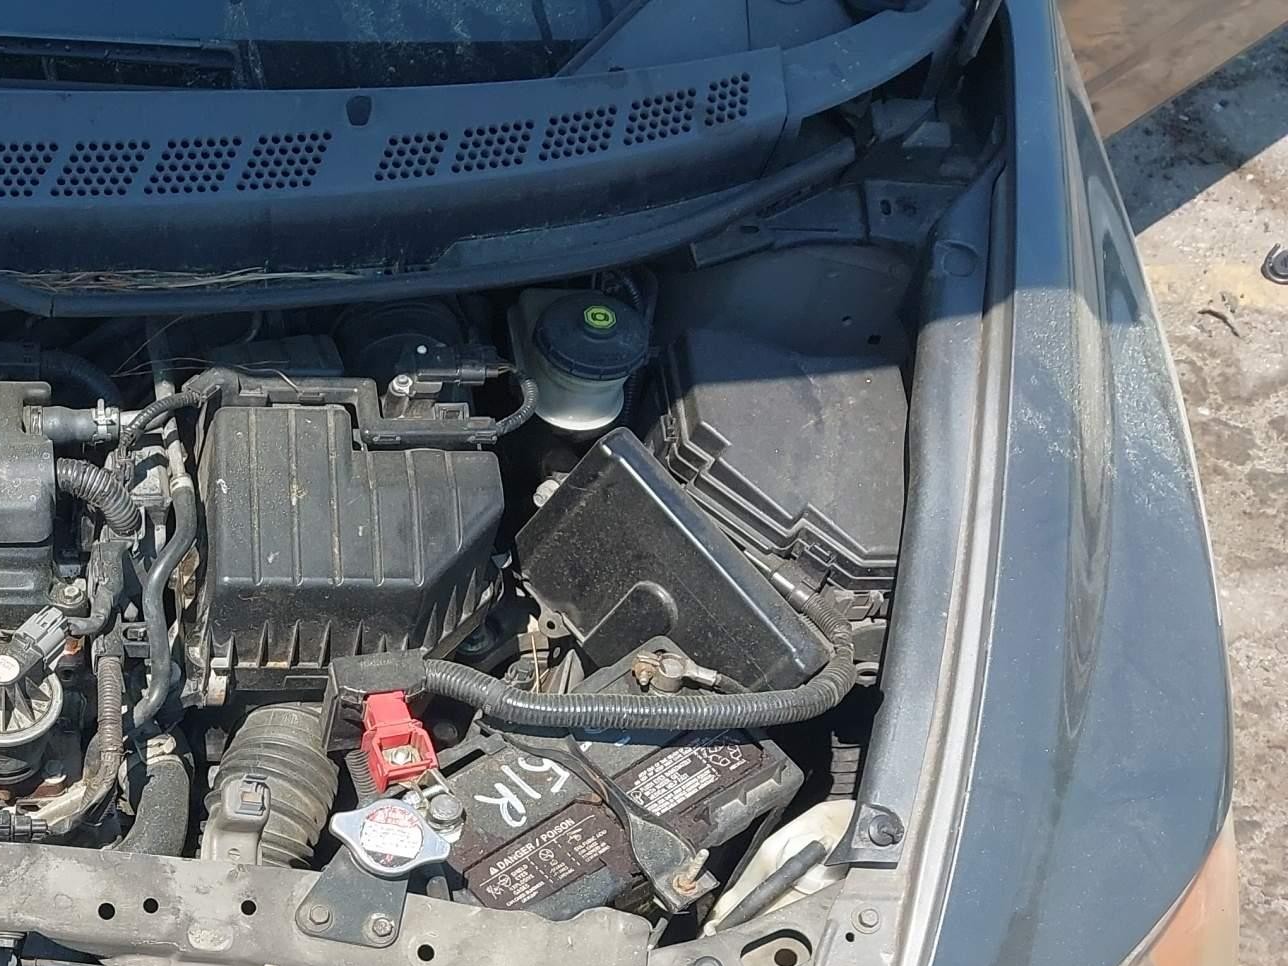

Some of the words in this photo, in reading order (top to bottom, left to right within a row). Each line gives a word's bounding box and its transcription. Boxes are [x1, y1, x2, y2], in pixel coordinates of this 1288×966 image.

[474, 757, 570, 827] 51R
[496, 846, 536, 870] DANGER
[540, 818, 575, 842] POISON
